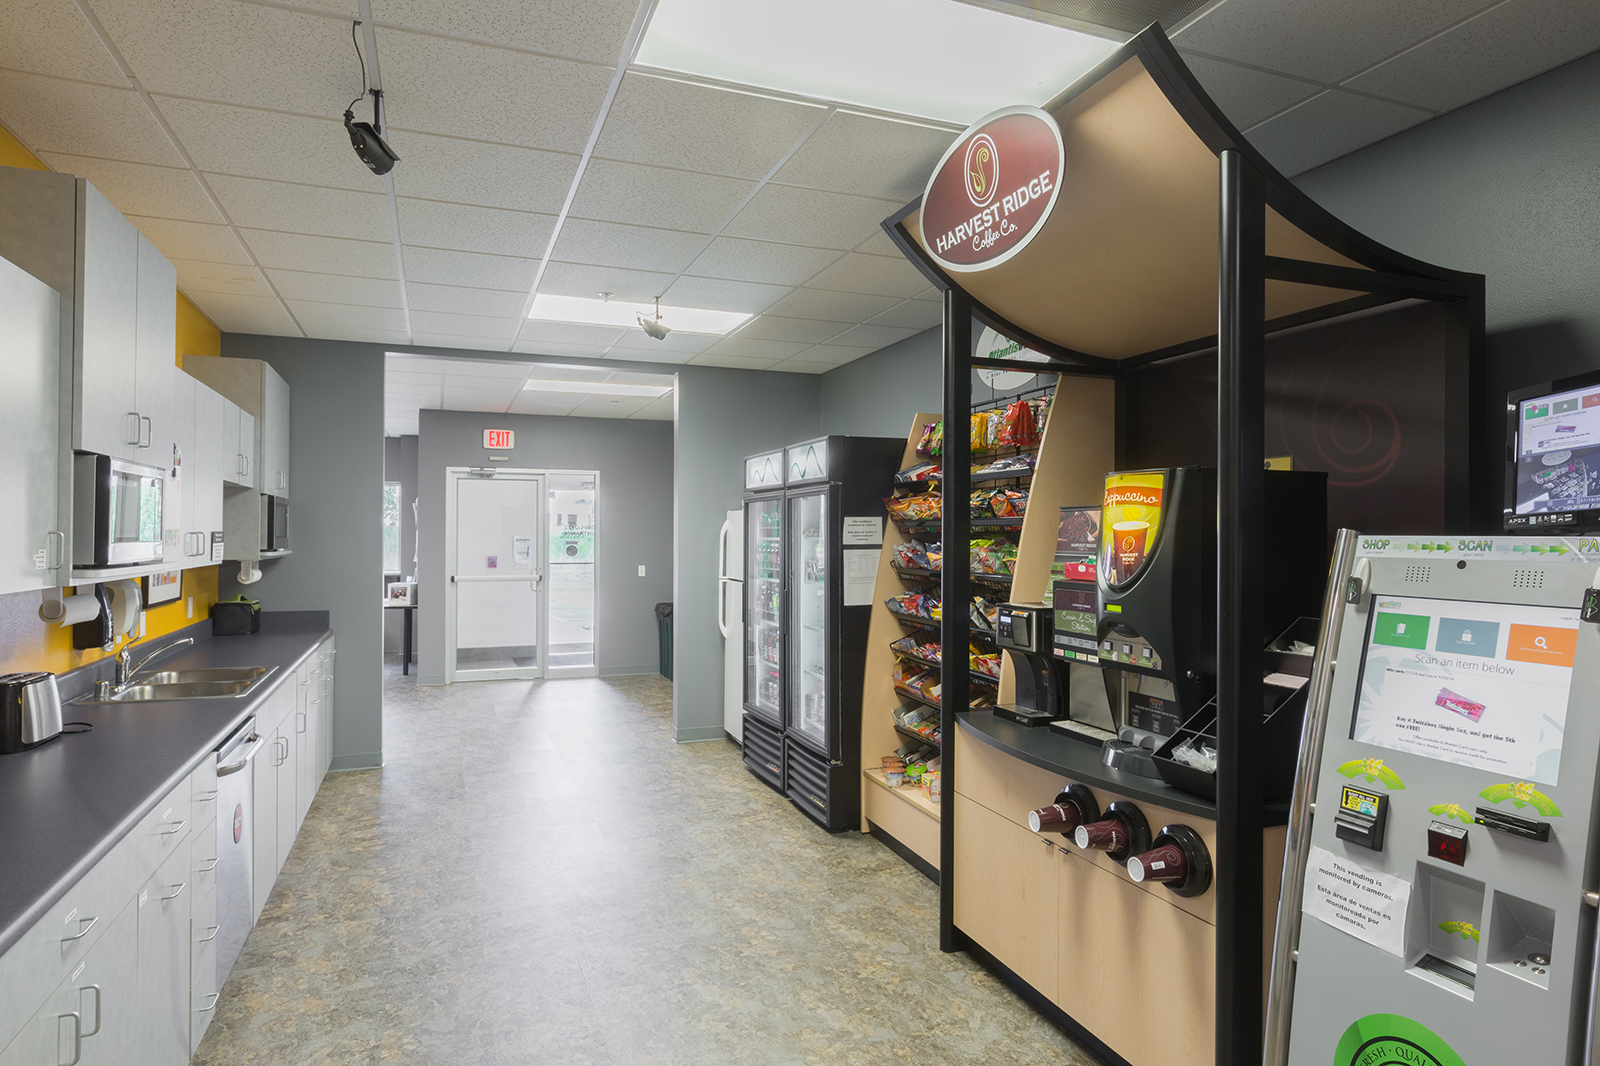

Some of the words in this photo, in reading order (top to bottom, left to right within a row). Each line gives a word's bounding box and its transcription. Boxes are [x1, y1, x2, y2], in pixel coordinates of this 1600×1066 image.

[936, 202, 1000, 254] HARVEST
[1002, 170, 1053, 216] RIDGE
[972, 228, 1000, 251] Coffee
[1000, 219, 1018, 236] Co.
[489, 431, 510, 447] EXIT
[1362, 540, 1390, 550] SHOP
[1458, 540, 1493, 551] SCAN
[1579, 539, 1599, 552] PA
[1085, 615, 1096, 628] Sug
[1415, 654, 1438, 665] Scan
[1440, 659, 1453, 667] an
[1455, 659, 1479, 670] item
[1482, 662, 1515, 675] below
[1406, 724, 1420, 732] FREE!
[1413, 719, 1437, 728] Twizzlers
[1438, 722, 1455, 732] Single
[1319, 868, 1351, 884] monitored
[1352, 881, 1360, 889] by
[1362, 885, 1393, 901] cameras.
[1333, 863, 1346, 873] This
[1347, 869, 1374, 885] vending
[1375, 879, 1382, 887] is
[1317, 885, 1331, 895] Esta
[1359, 903, 1381, 916] ventas
[1326, 899, 1366, 919] monitoreada
[1368, 917, 1380, 926] por
[1395, 1046, 1433, 1066] QUAL
